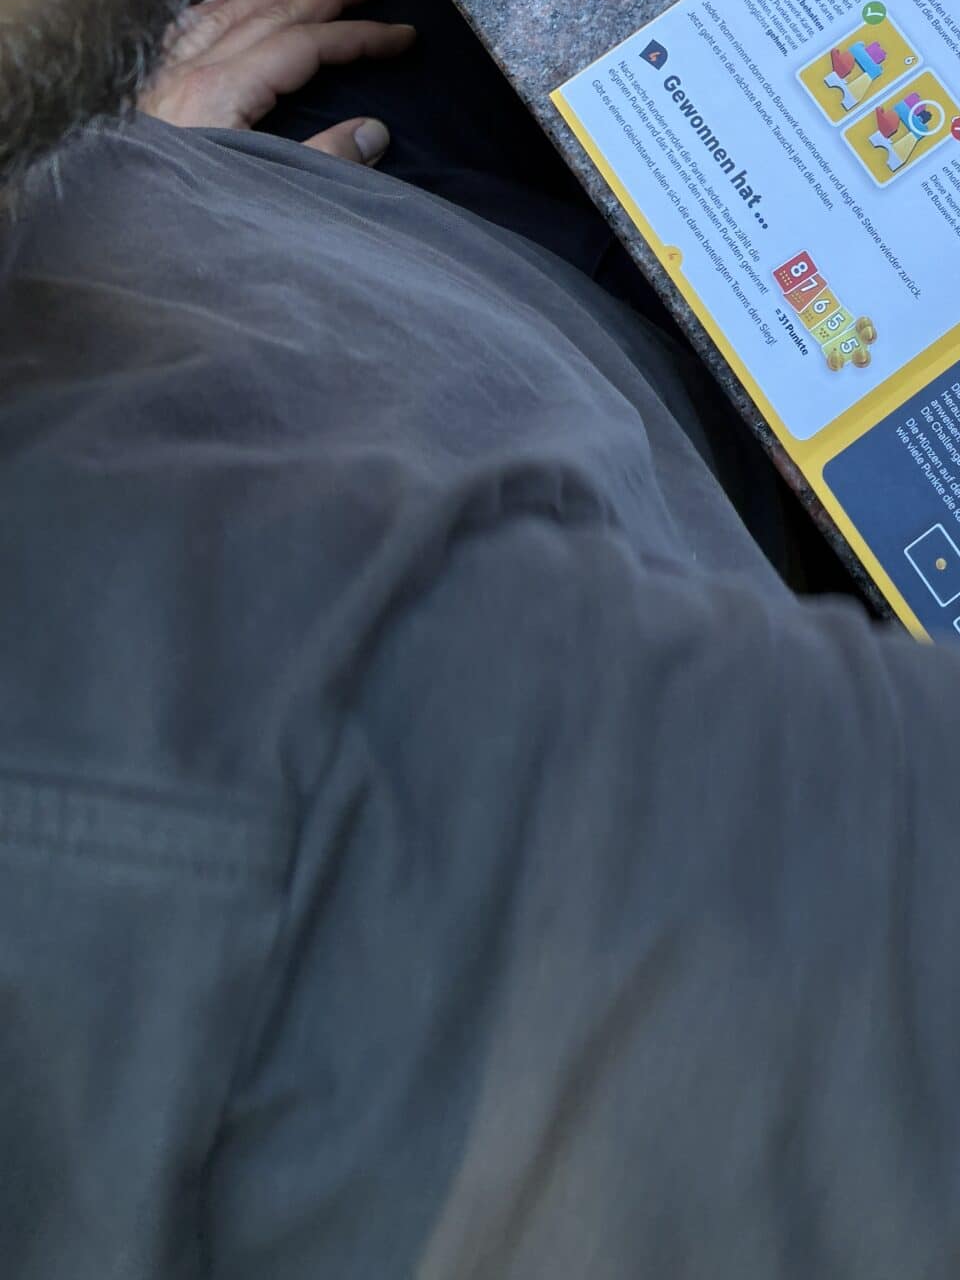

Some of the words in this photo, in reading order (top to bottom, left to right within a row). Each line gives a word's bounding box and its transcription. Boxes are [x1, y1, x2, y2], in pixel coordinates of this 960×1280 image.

[663, 74, 736, 175] Gewonnen
[729, 169, 763, 209] hat
[778, 313, 790, 326] 31
[784, 323, 809, 356] Punkte
[789, 260, 809, 278] 8
[799, 276, 818, 293] 7
[812, 296, 832, 314] 6
[826, 312, 845, 331] 5
[839, 335, 860, 354] 5
[905, 417, 919, 435] Die
[915, 432, 943, 469] Münzen
[939, 467, 956, 483] auf
[920, 406, 934, 423] Die
[895, 426, 910, 444] wie
[906, 442, 925, 465] viele
[920, 462, 946, 496] Punkte
[942, 494, 956, 511] die
